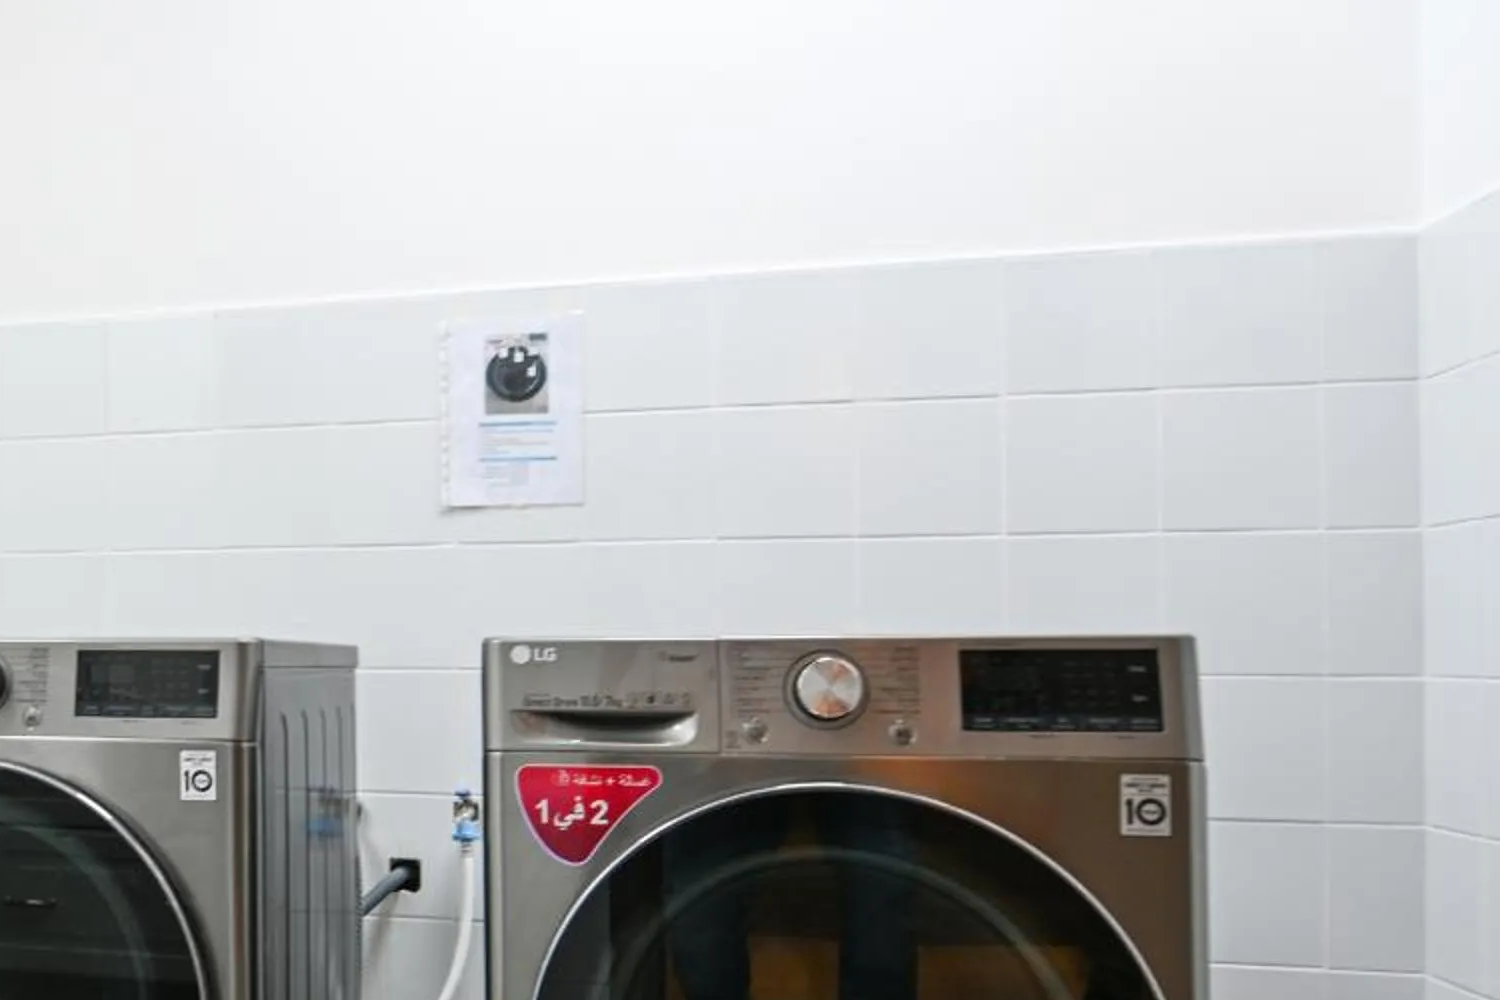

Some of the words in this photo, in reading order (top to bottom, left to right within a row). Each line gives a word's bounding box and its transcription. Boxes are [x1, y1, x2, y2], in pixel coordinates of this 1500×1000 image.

[533, 647, 558, 662] LG
[184, 769, 213, 792] 10
[534, 798, 549, 824] 1
[553, 795, 586, 831] في
[589, 799, 609, 825] 2
[1125, 797, 1167, 826] 10
